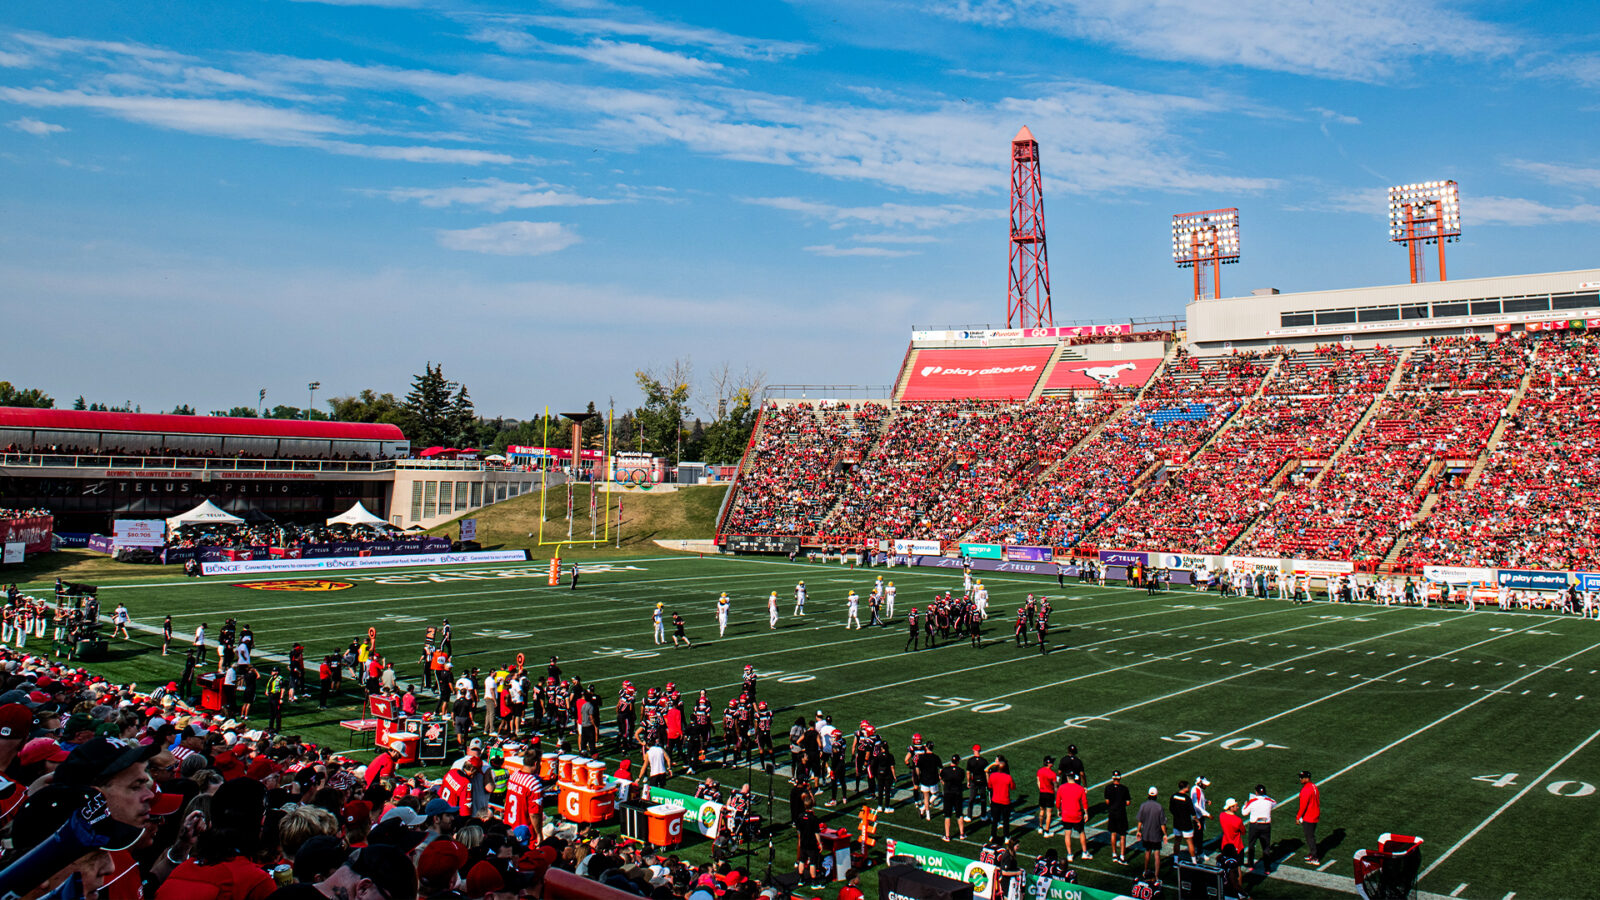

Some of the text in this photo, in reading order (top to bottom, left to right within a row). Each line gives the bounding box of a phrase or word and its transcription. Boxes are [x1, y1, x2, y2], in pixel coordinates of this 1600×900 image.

[1031, 329, 1048, 337] GO
[942, 365, 1036, 376] play alberta
[120, 482, 288, 492] TELUS Patio
[1512, 575, 1566, 584] play alberta
[592, 646, 660, 660] 30
[923, 694, 1012, 713] 50
[1160, 730, 1264, 750] 50
[1471, 772, 1596, 797] 40
[566, 792, 580, 816] G
[652, 796, 664, 804] GET
[672, 798, 684, 807] ON
[508, 794, 518, 824] 3
[668, 818, 680, 836] G
[916, 854, 942, 866] IN ON
[1051, 889, 1082, 900] IN ON
